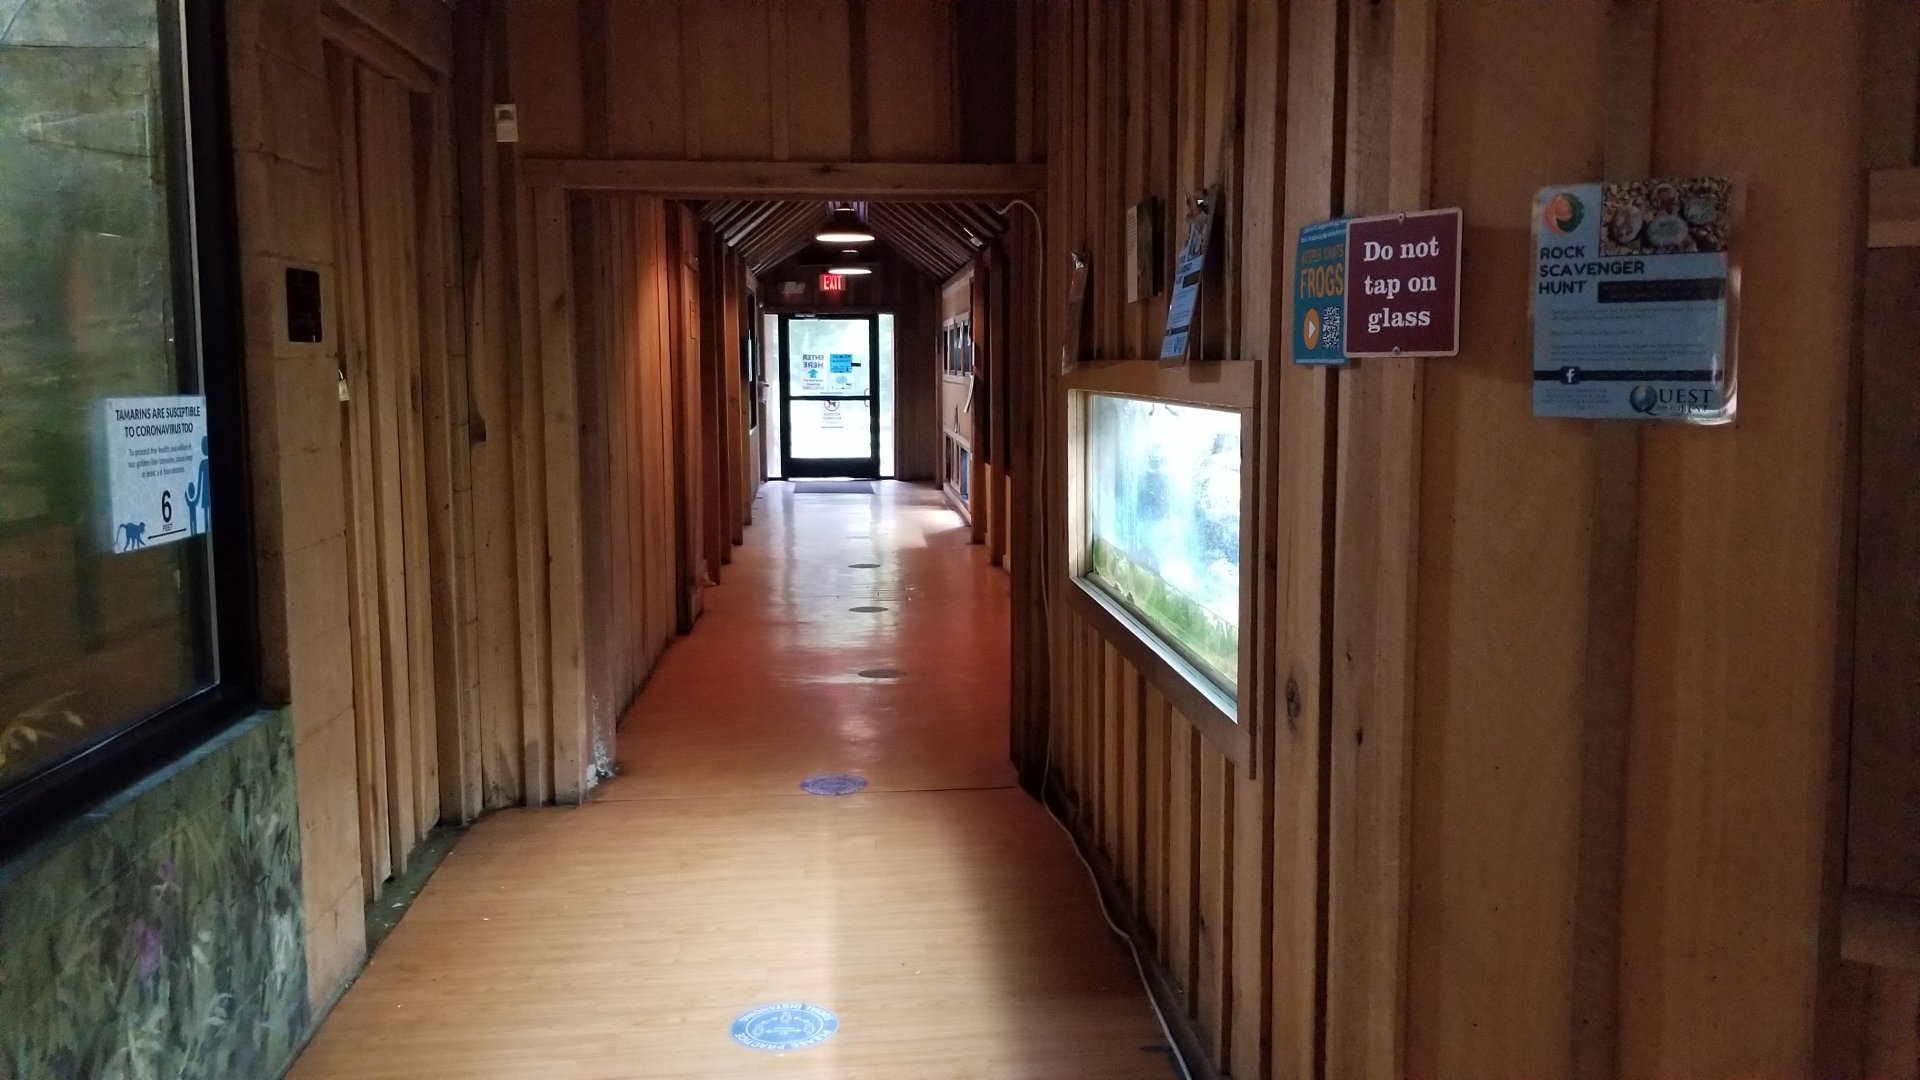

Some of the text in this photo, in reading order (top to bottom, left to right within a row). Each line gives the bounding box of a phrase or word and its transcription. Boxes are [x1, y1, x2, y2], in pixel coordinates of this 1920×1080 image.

[1364, 236, 1439, 261] Do not
[1540, 246, 1585, 259] ROCK
[1539, 261, 1645, 277] SCAVENGER
[824, 275, 842, 290] EXIT
[1300, 263, 1344, 299] FROGS
[1364, 276, 1437, 299] tap on
[1538, 280, 1586, 295] HUNT
[1368, 308, 1430, 333] glass
[115, 406, 200, 421] TAMARINS ARE SUSCEPTIBLE
[124, 422, 193, 438] TO CORONAVIRUS TOO
[161, 490, 172, 522] 6
[162, 523, 173, 532] FEET
